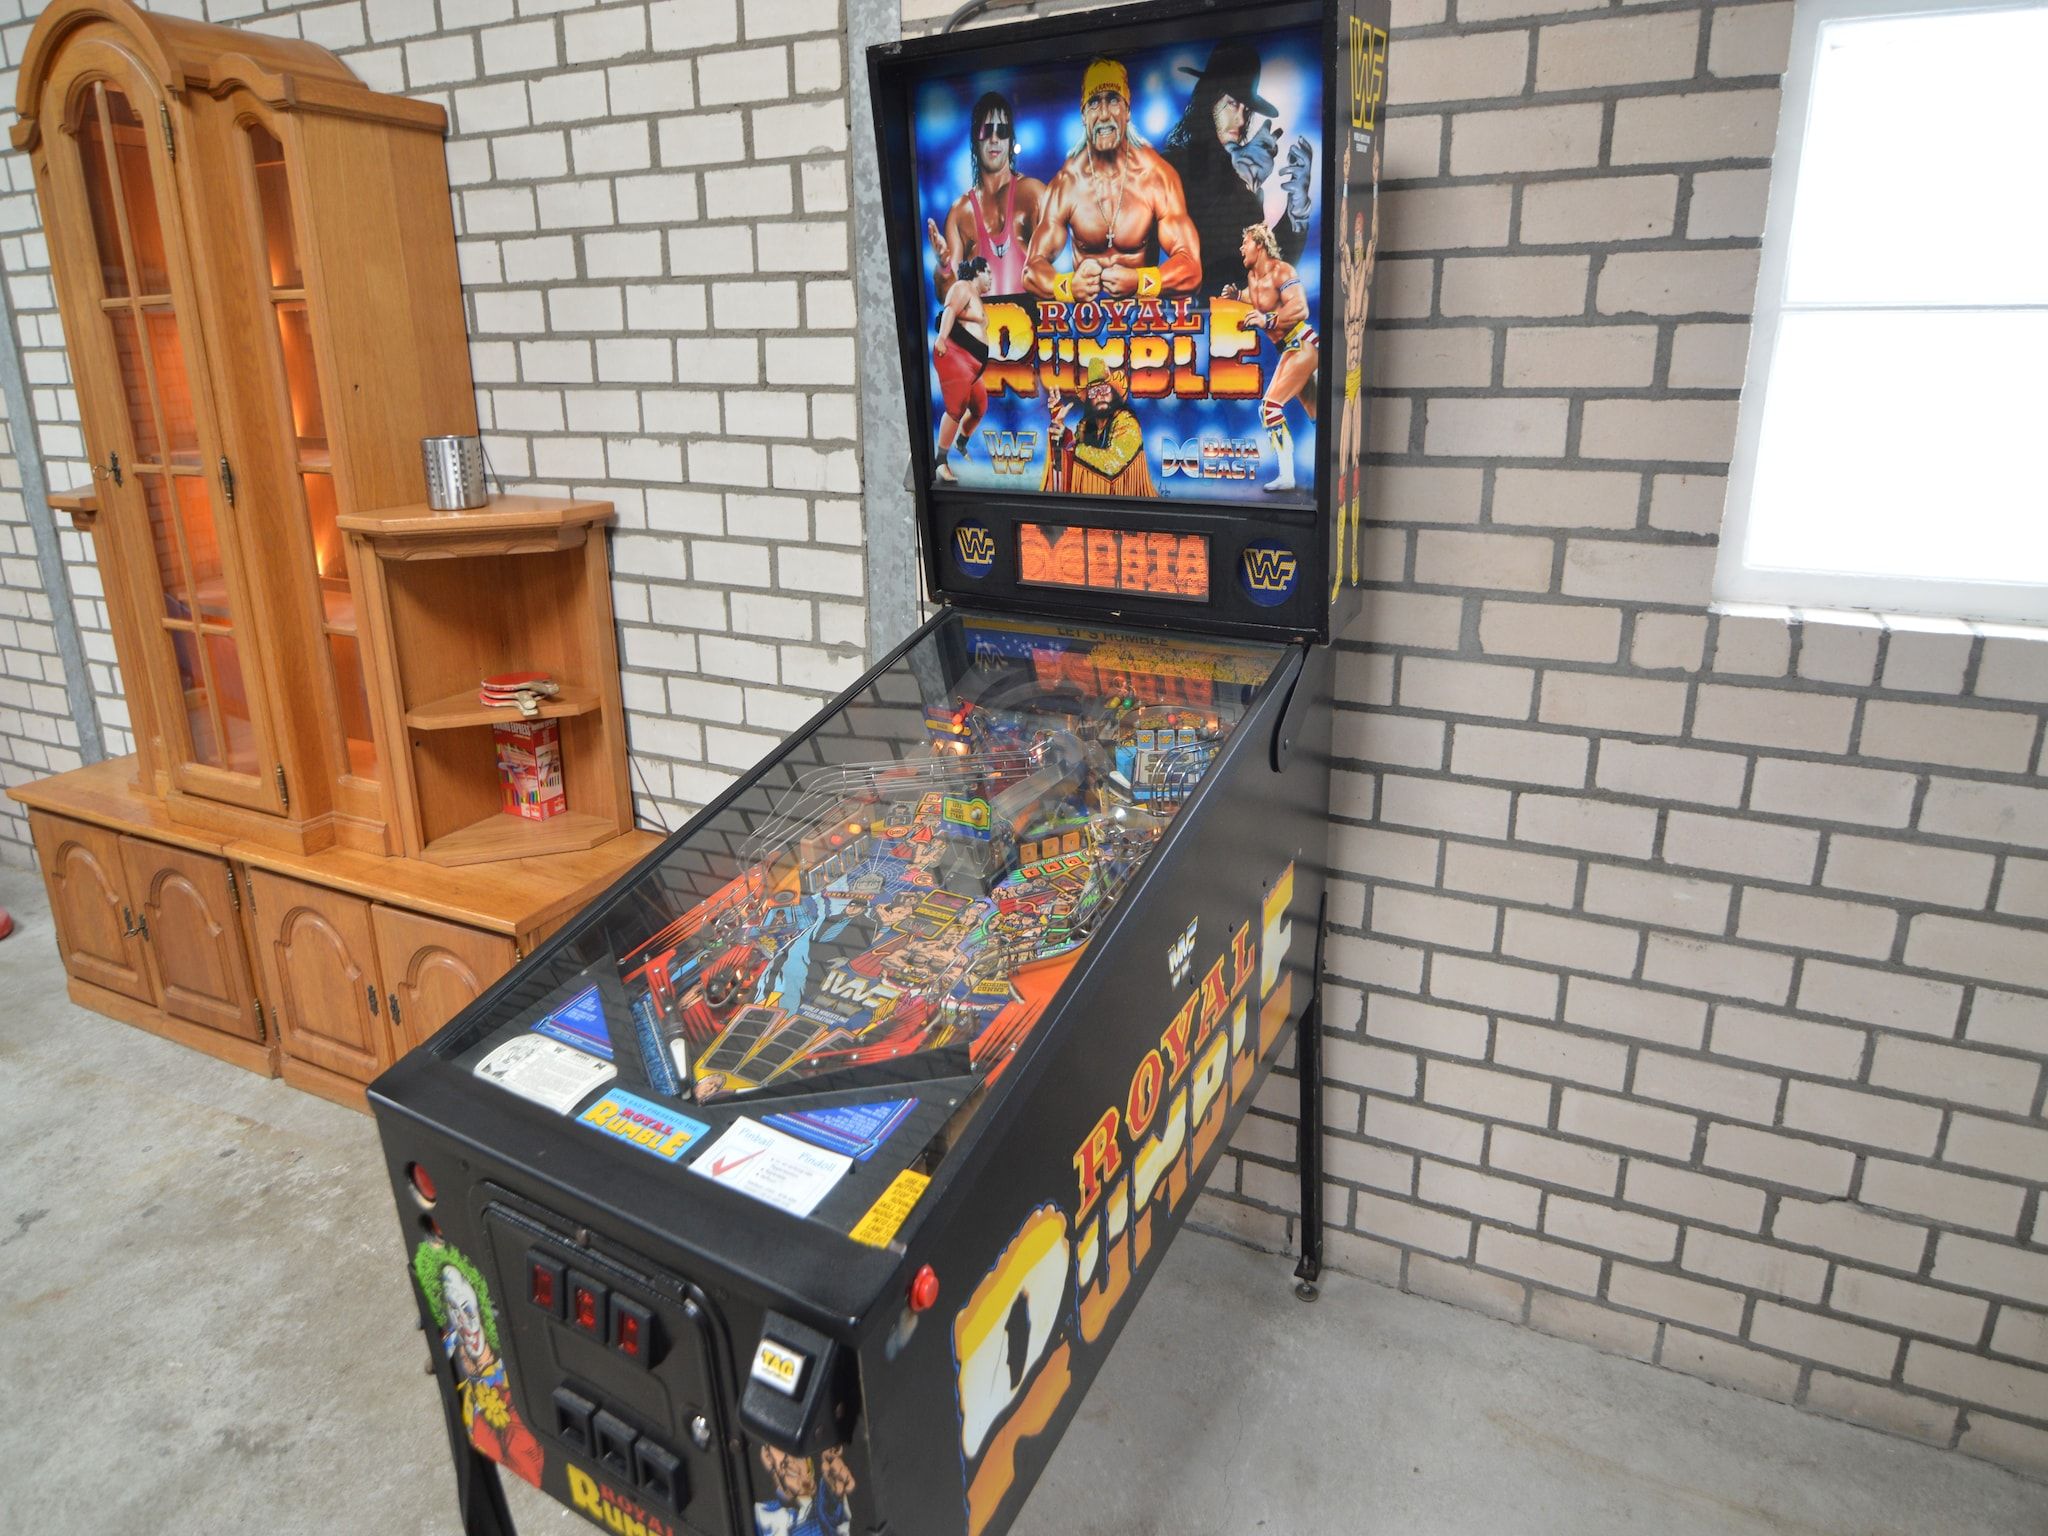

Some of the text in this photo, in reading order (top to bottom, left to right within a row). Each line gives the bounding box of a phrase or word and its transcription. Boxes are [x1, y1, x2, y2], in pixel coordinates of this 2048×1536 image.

[1036, 297, 1201, 334] ROYAL
[983, 297, 1263, 399] RUMBLE
[1202, 438, 1260, 458] DATA
[1202, 460, 1260, 480] EAST
[1074, 919, 1257, 1229] ROYAL
[583, 1099, 694, 1158] RUMBLE
[619, 1107, 674, 1136] ROYAL
[566, 1462, 662, 1536] RUM
